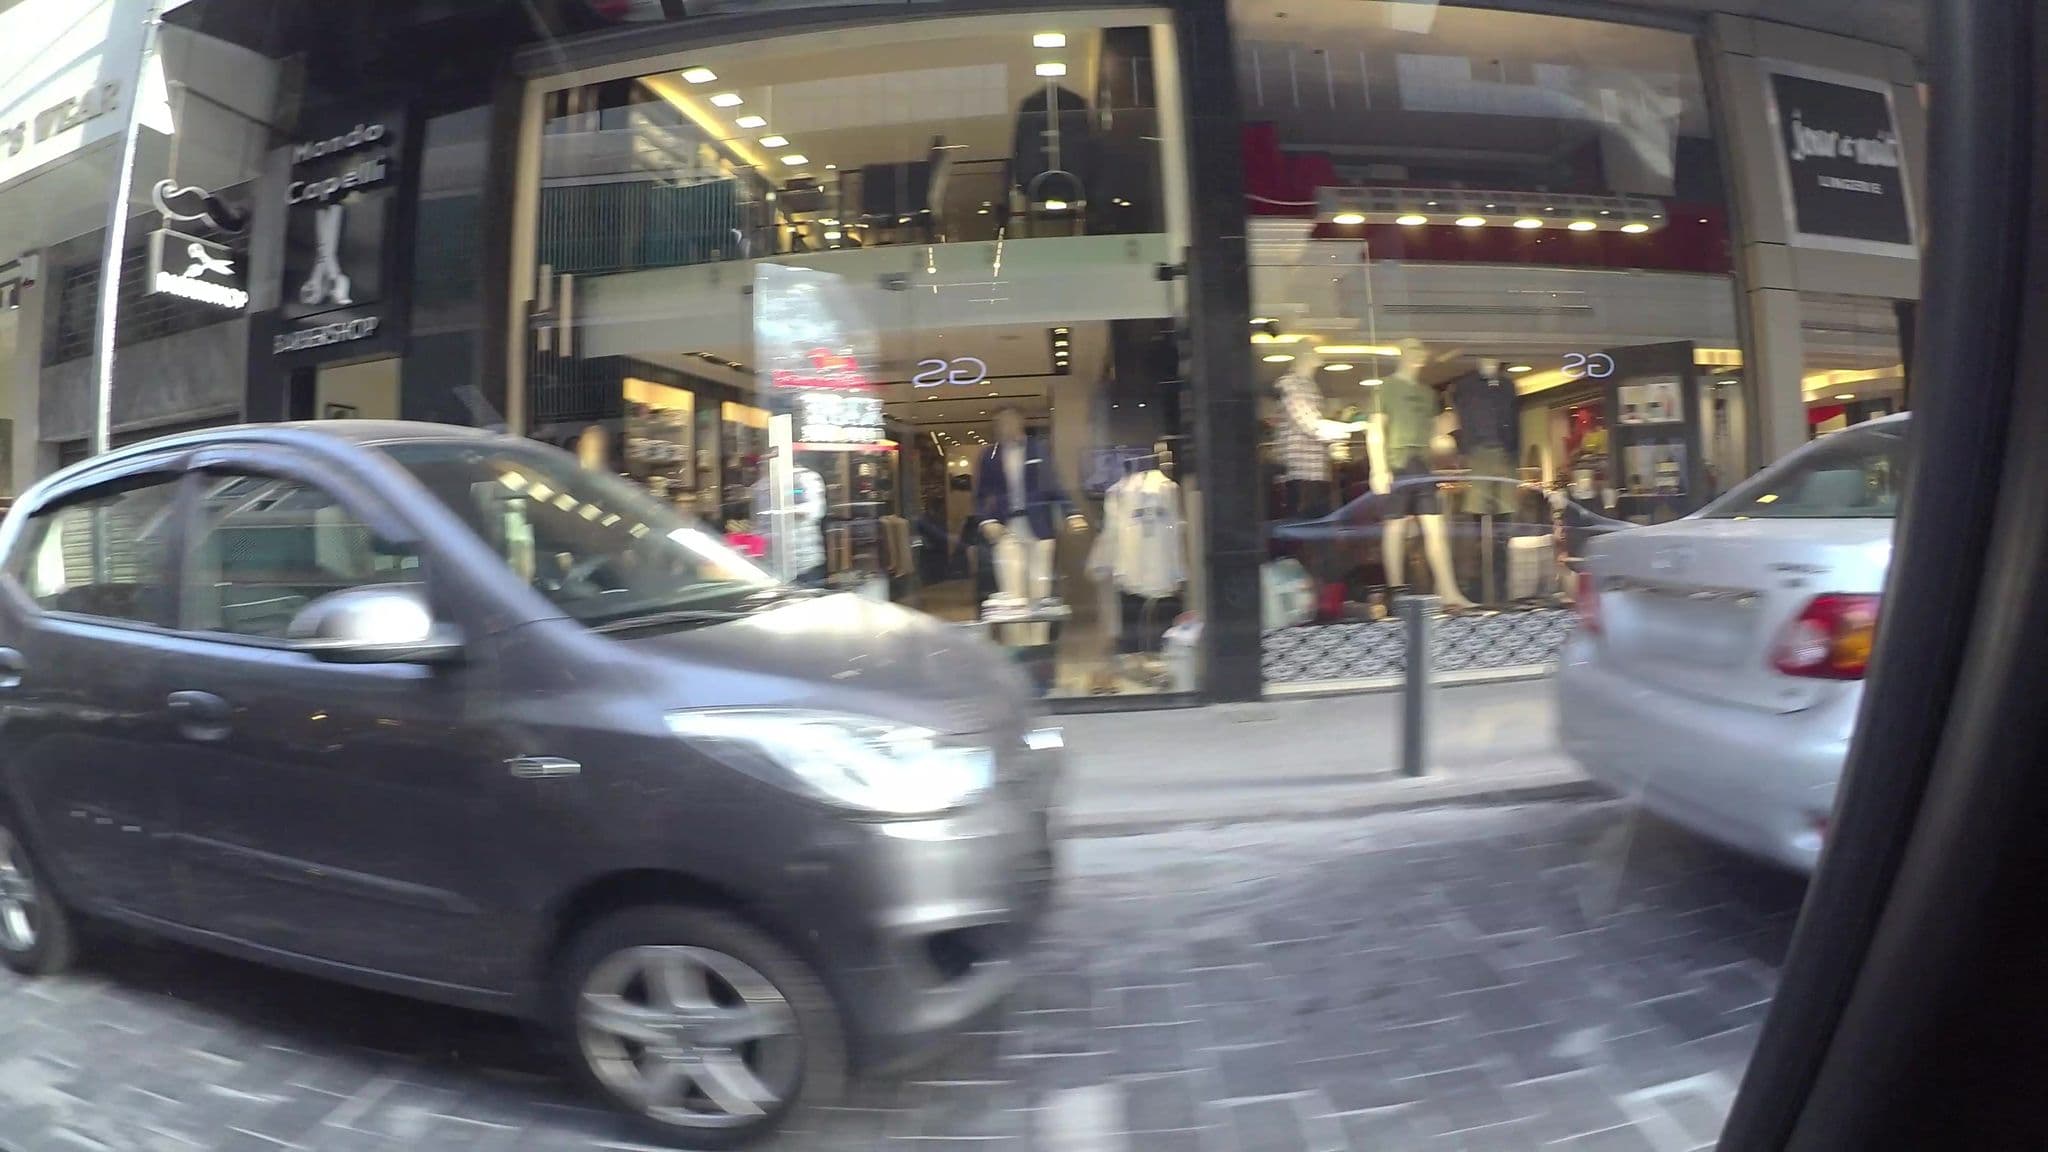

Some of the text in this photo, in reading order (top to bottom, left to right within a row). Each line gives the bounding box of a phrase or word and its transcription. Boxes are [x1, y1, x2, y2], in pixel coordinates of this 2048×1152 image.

[293, 124, 385, 165] Mondo
[287, 155, 386, 205] Capelli
[1817, 175, 1883, 195] LINGERIE
[272, 316, 378, 355] BARBERSHOP
